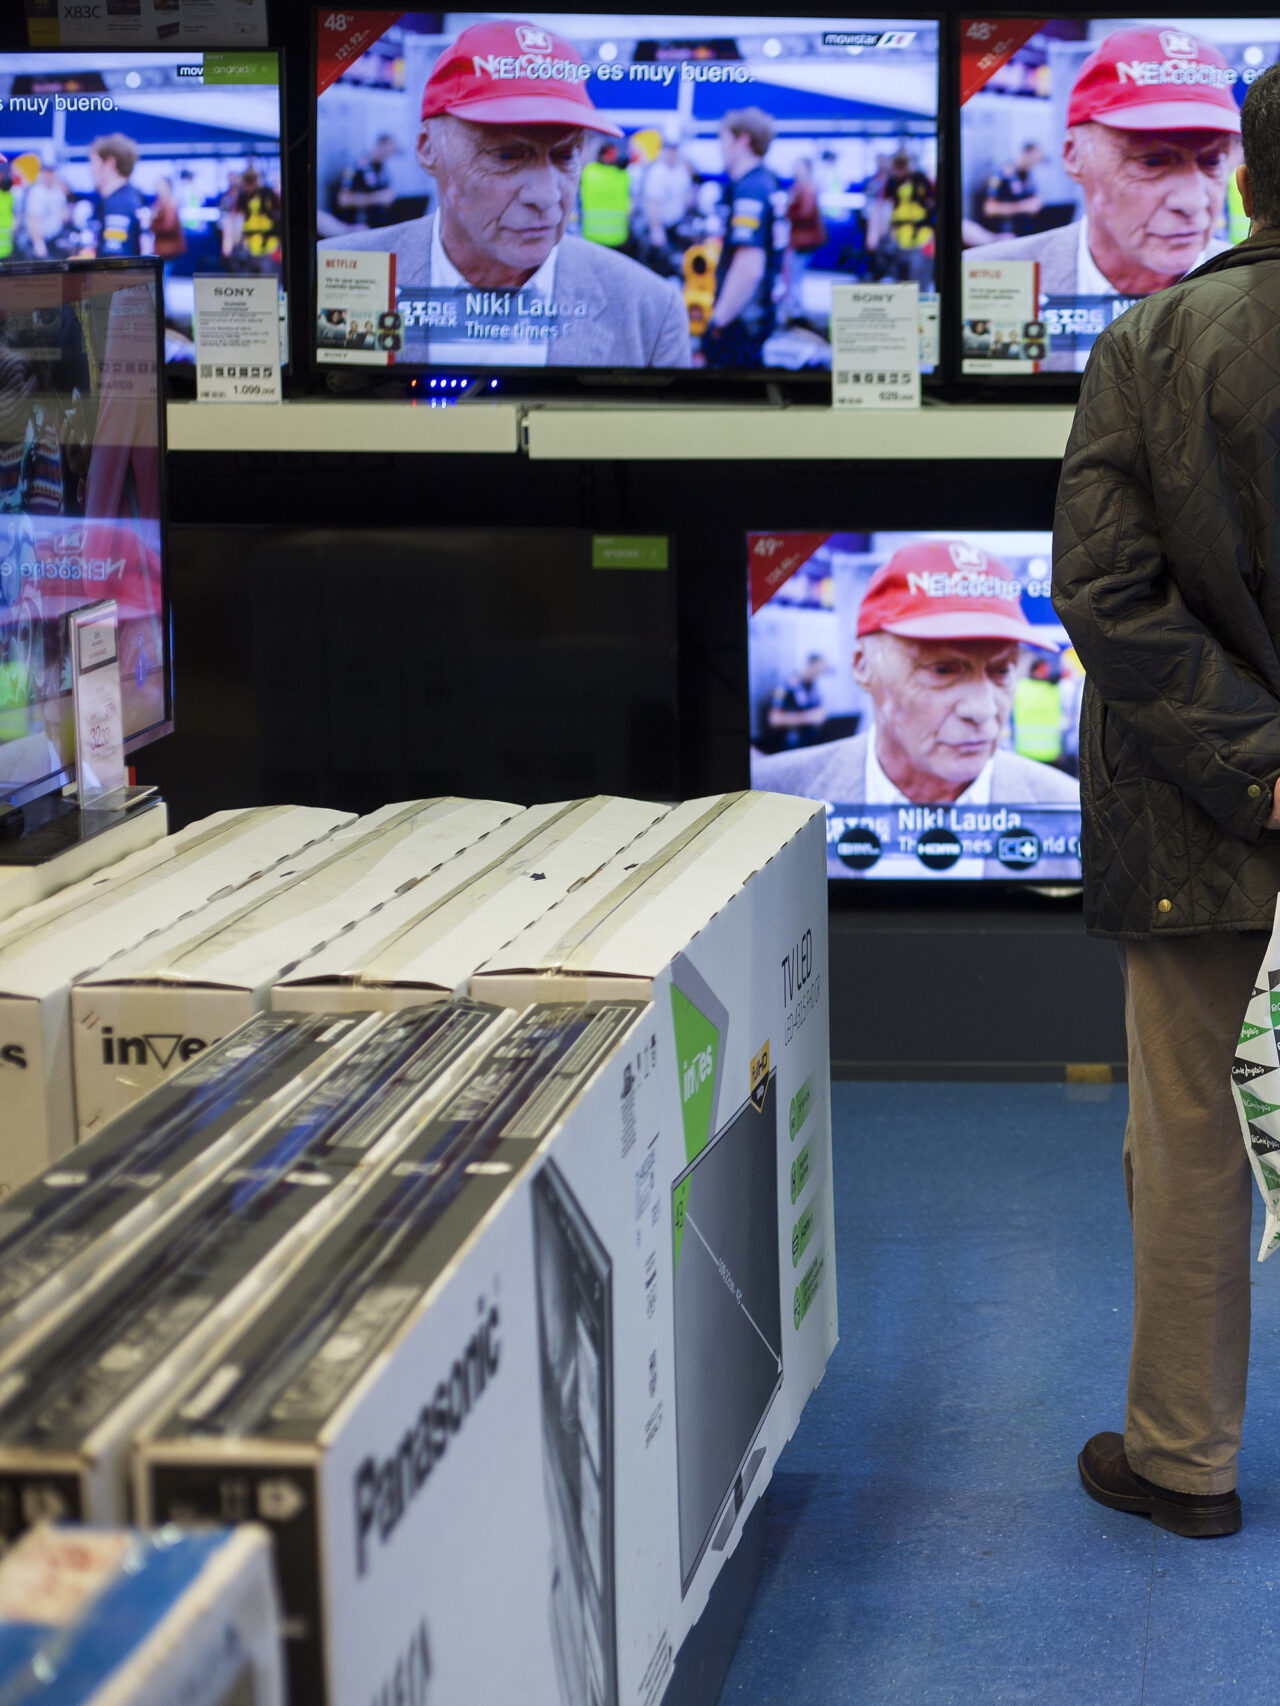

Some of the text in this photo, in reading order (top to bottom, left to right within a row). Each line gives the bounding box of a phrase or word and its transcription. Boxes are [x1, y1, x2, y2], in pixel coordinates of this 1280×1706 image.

[64, 5, 101, 19] X83C
[500, 59, 755, 86] El coche es muy bueno.
[9, 94, 118, 115] muy bueno.
[325, 259, 358, 269] NETFLIX
[214, 287, 255, 296] SONY
[852, 293, 895, 302] SONY
[466, 292, 510, 316] Niki
[466, 321, 559, 340] Three times
[899, 808, 945, 831] Niki
[950, 808, 1021, 832] Lauda
[781, 928, 812, 1009] TV LED
[1272, 1004, 1277, 1012] El
[1244, 1064, 1264, 1076] Inglés
[354, 1295, 500, 1582] Panasonic
